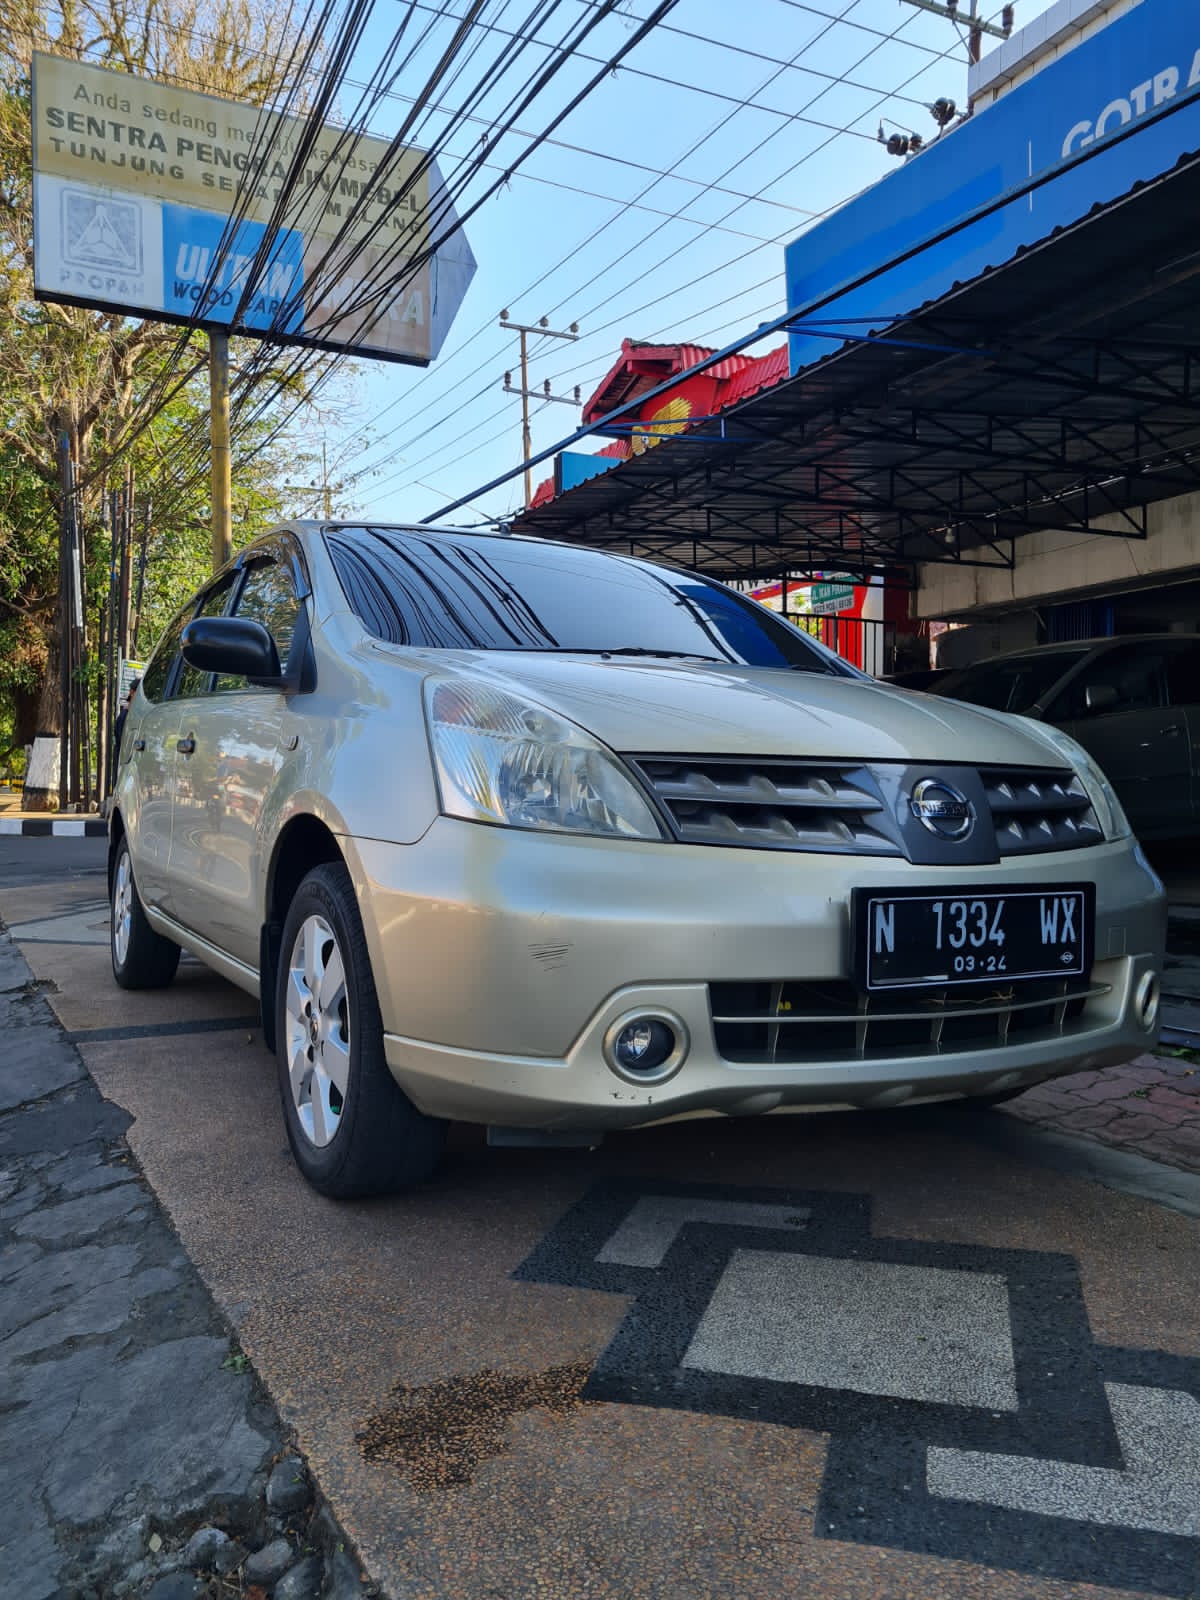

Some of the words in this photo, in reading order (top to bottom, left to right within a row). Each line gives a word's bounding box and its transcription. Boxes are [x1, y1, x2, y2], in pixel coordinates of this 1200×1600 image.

[46, 106, 167, 153] SENTRA
[73, 83, 131, 113] Anda
[142, 104, 217, 138] sedang
[309, 146, 389, 177] kawasa
[49, 136, 184, 180] TUNJUNG
[325, 201, 421, 235] MLNG
[173, 281, 234, 307] WOOD
[875, 903, 895, 953] N
[932, 900, 1005, 950] 1334
[1039, 897, 1076, 945] WX
